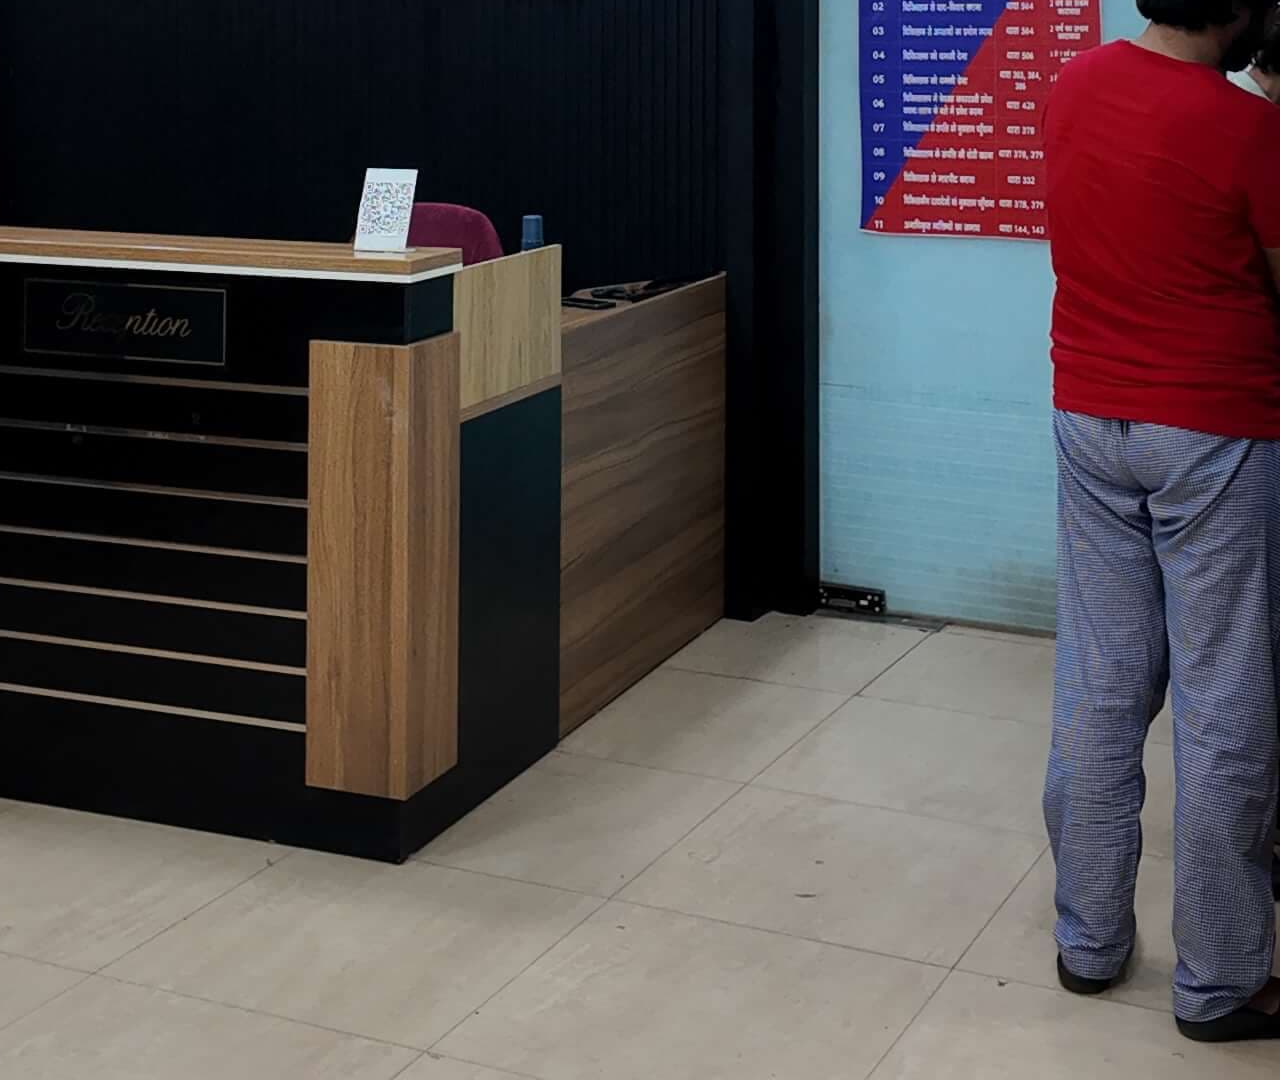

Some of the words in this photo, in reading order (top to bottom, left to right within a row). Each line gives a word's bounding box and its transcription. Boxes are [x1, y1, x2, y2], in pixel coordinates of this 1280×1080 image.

[872, 2, 884, 11] 02
[872, 26, 884, 36] 03
[872, 50, 885, 60] 04
[872, 75, 885, 84] 05
[872, 99, 884, 108] 06
[872, 123, 885, 133] 07
[873, 172, 885, 181] 09
[874, 196, 884, 205] 10
[873, 220, 884, 229] 11
